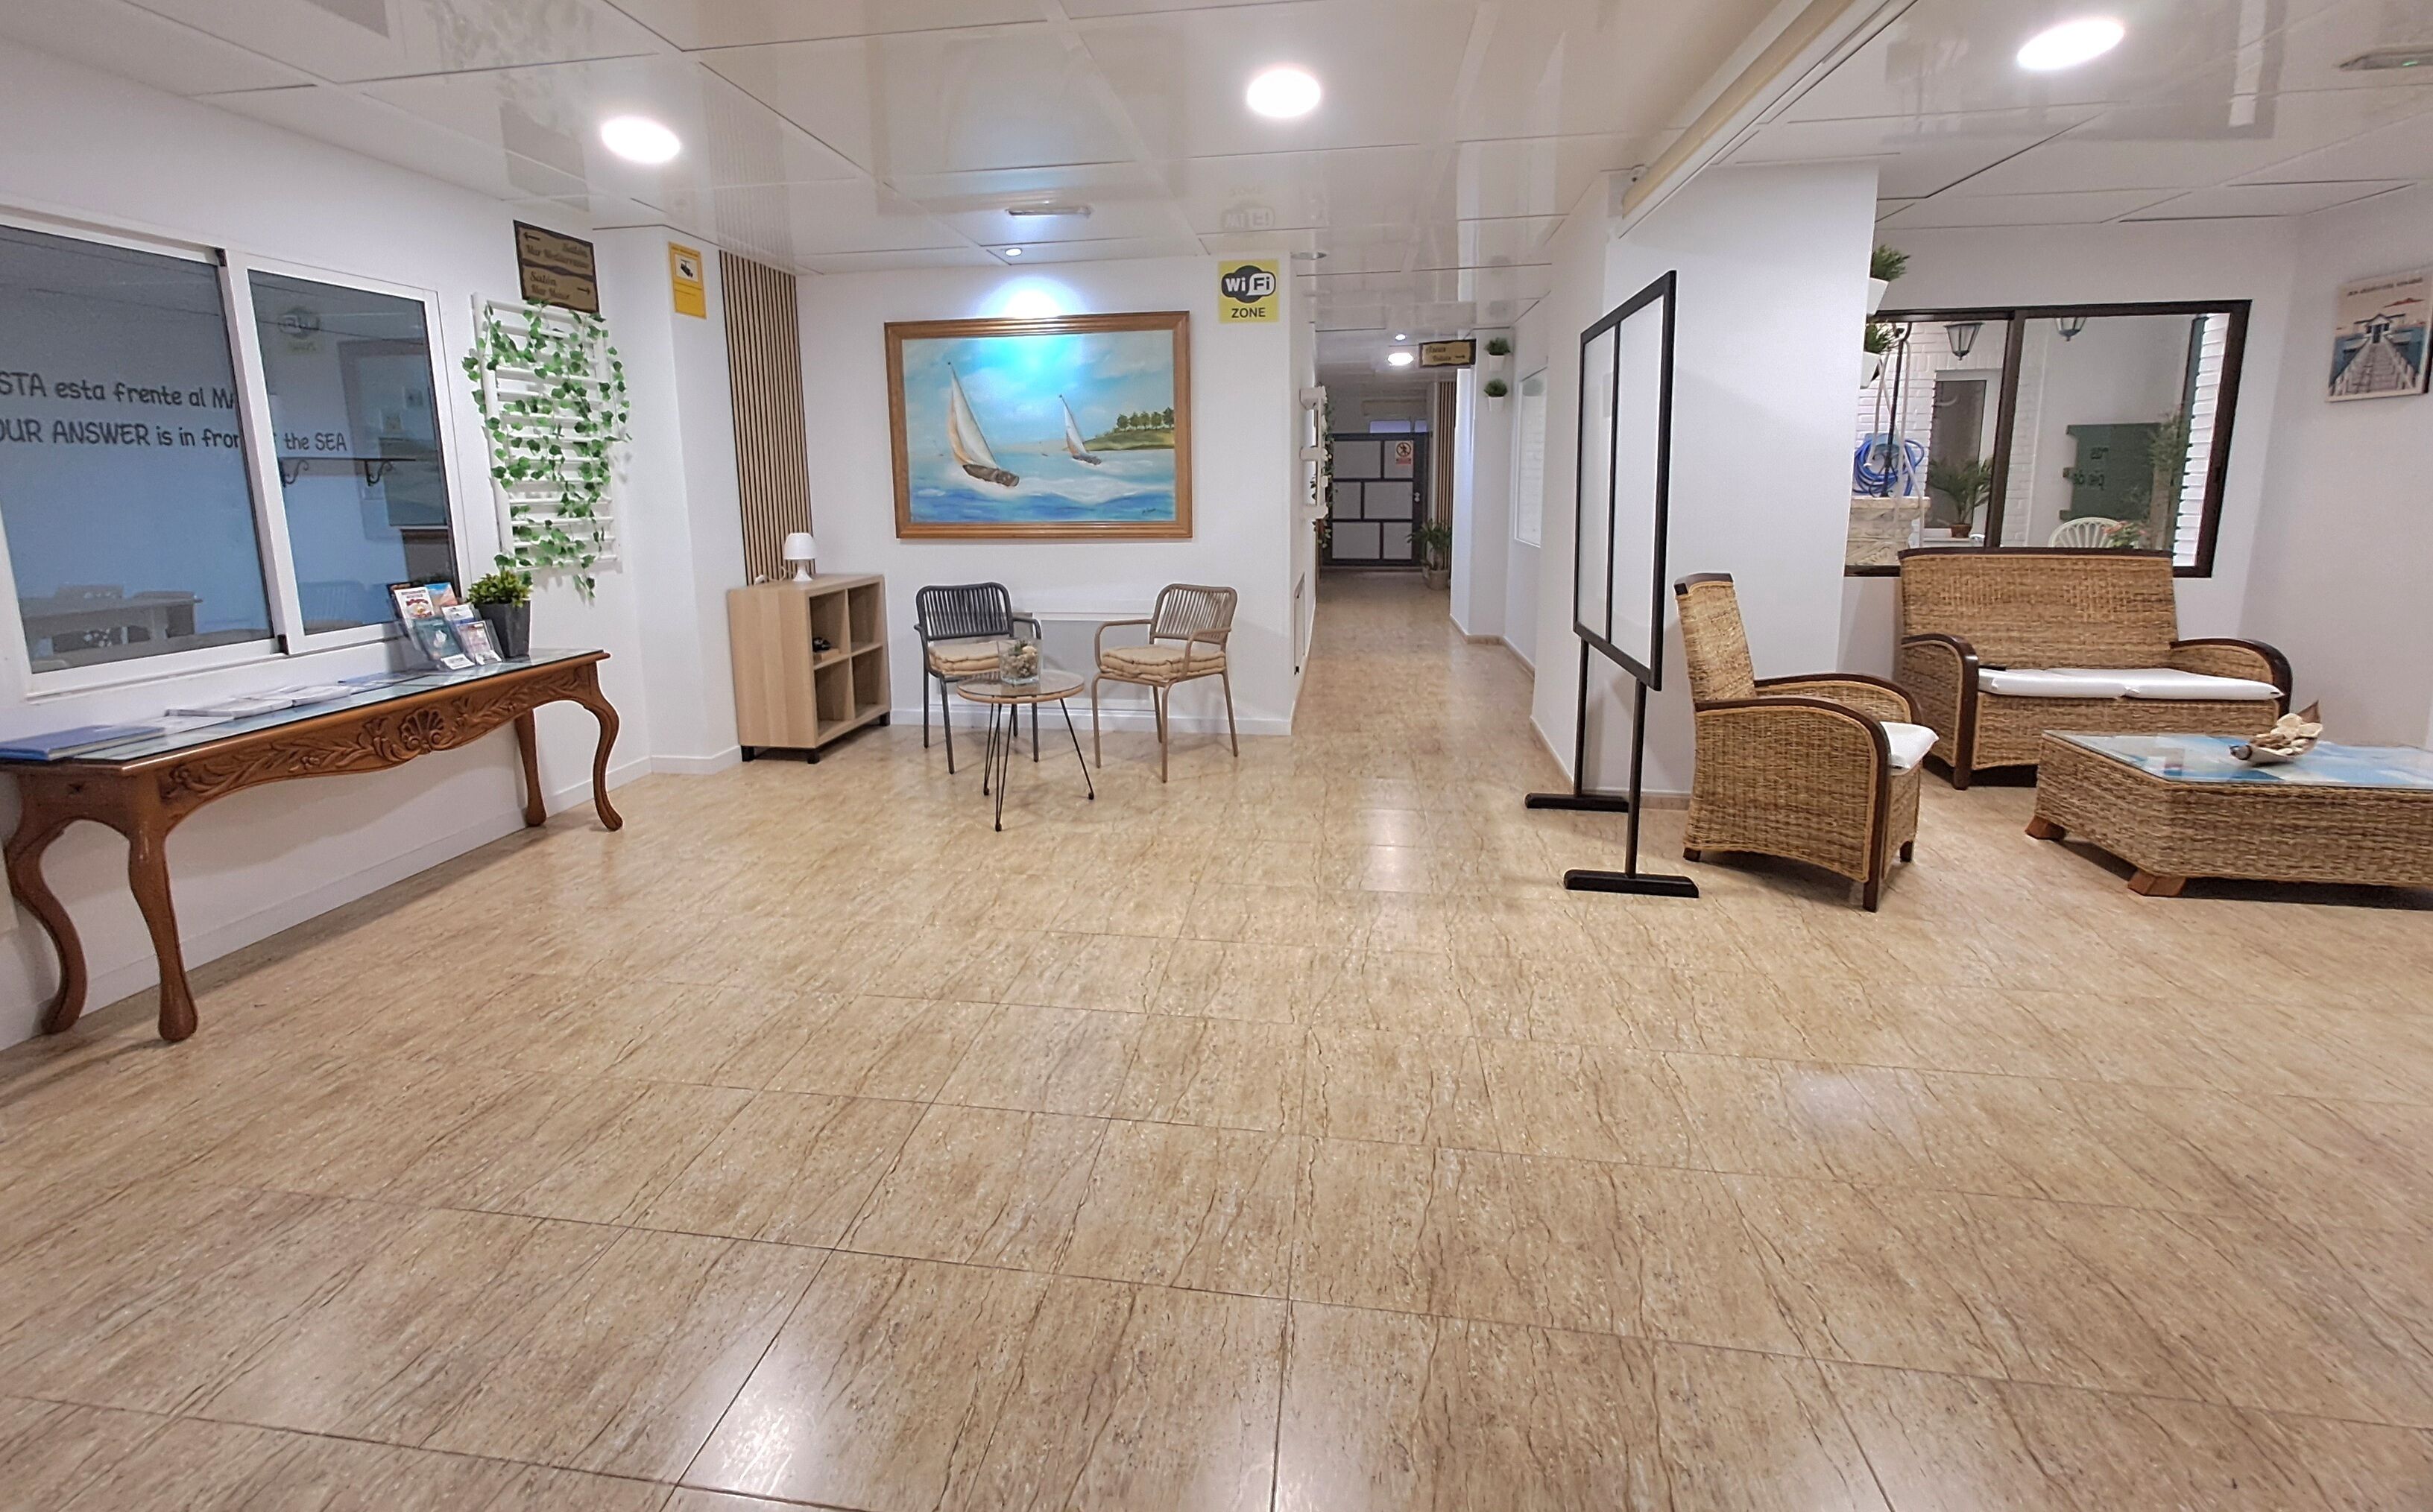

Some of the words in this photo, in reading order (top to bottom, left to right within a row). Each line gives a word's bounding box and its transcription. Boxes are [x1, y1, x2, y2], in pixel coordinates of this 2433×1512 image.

[1231, 308, 1266, 318] ZONE
[55, 379, 105, 401] esta
[113, 382, 183, 406] frente
[189, 388, 206, 408] al
[52, 420, 150, 446] ANSWER
[157, 426, 172, 446] is
[179, 427, 195, 447] in
[284, 431, 310, 450] the
[315, 432, 347, 451] SEA
